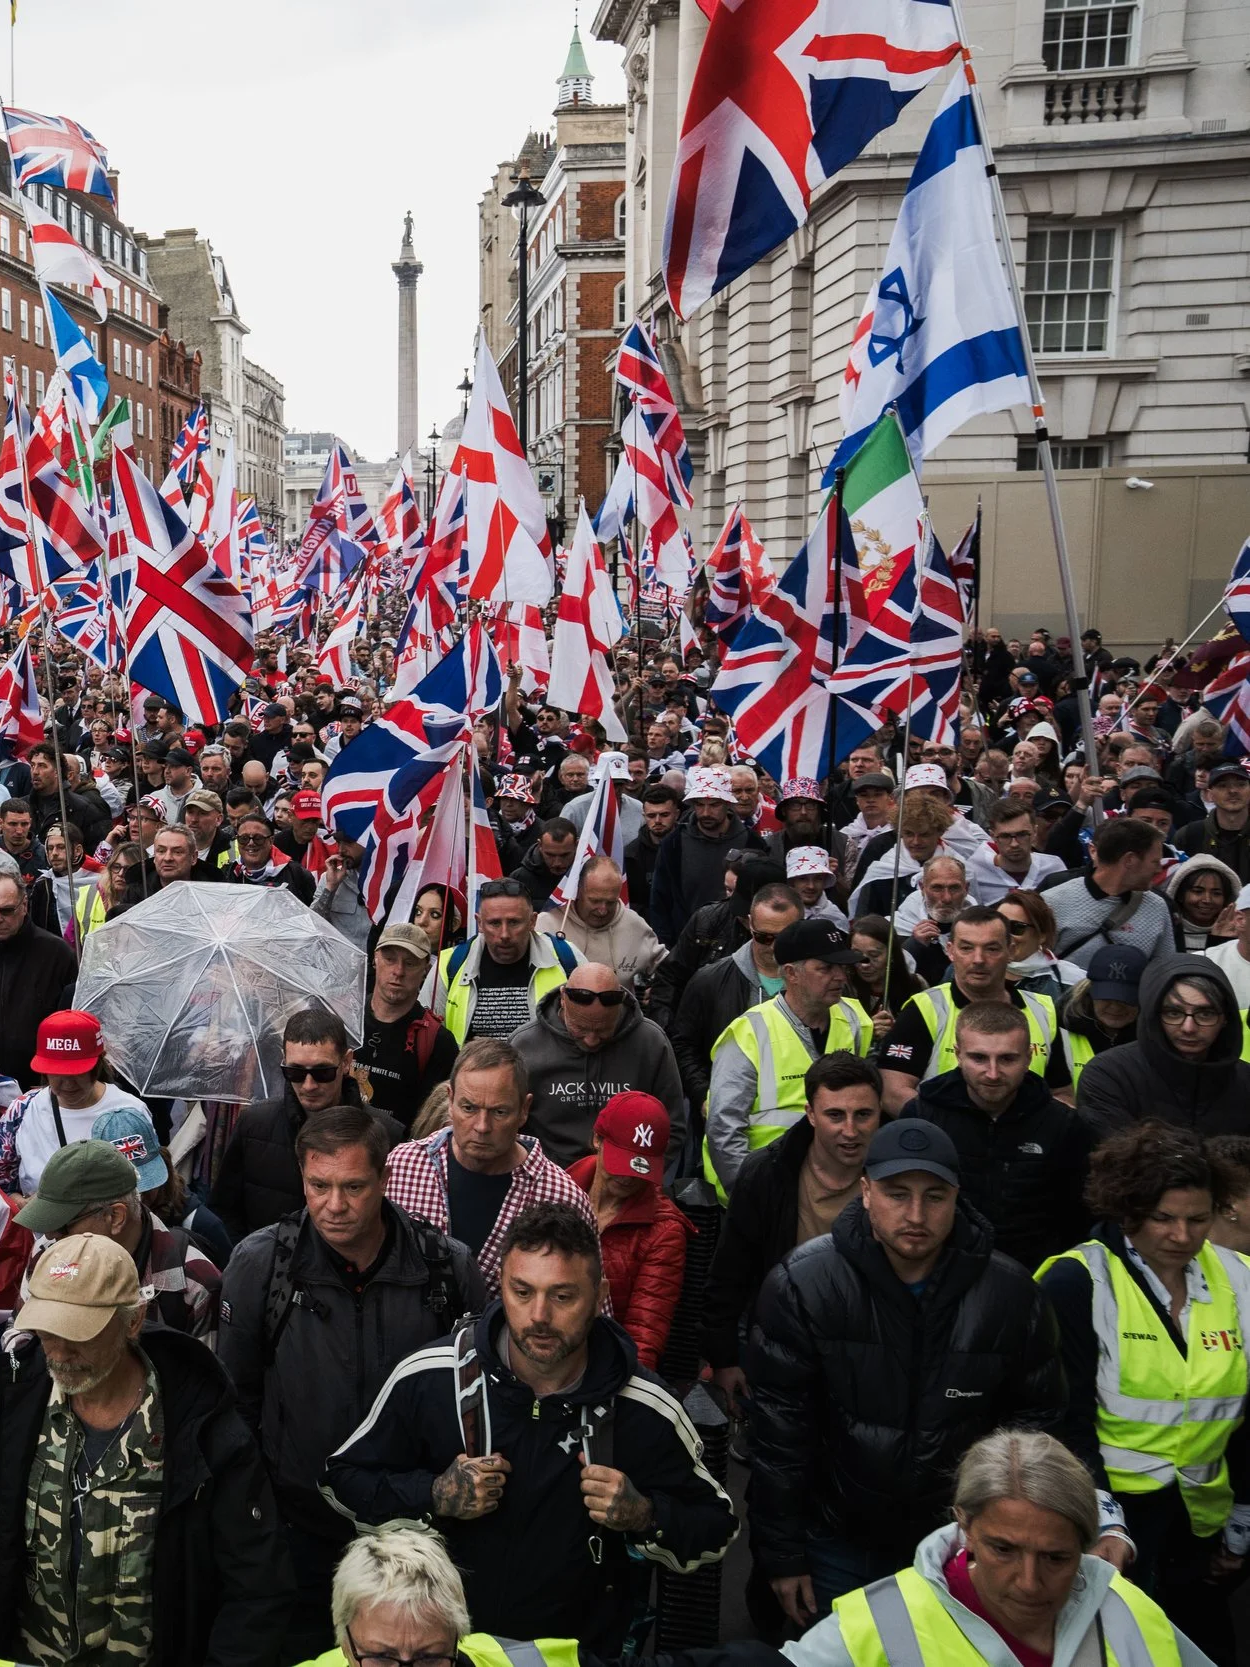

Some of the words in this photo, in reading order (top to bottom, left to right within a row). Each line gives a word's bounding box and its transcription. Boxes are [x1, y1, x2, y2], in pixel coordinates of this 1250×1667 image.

[618, 956, 637, 969] dad
[46, 1038, 81, 1051] MEGA
[371, 1066, 388, 1076] WHITE
[549, 1082, 586, 1096] JACK
[591, 1082, 631, 1096] WILLS
[560, 1095, 586, 1103] GREAT
[632, 1122, 654, 1148] NY
[49, 1266, 79, 1276] BOWIE
